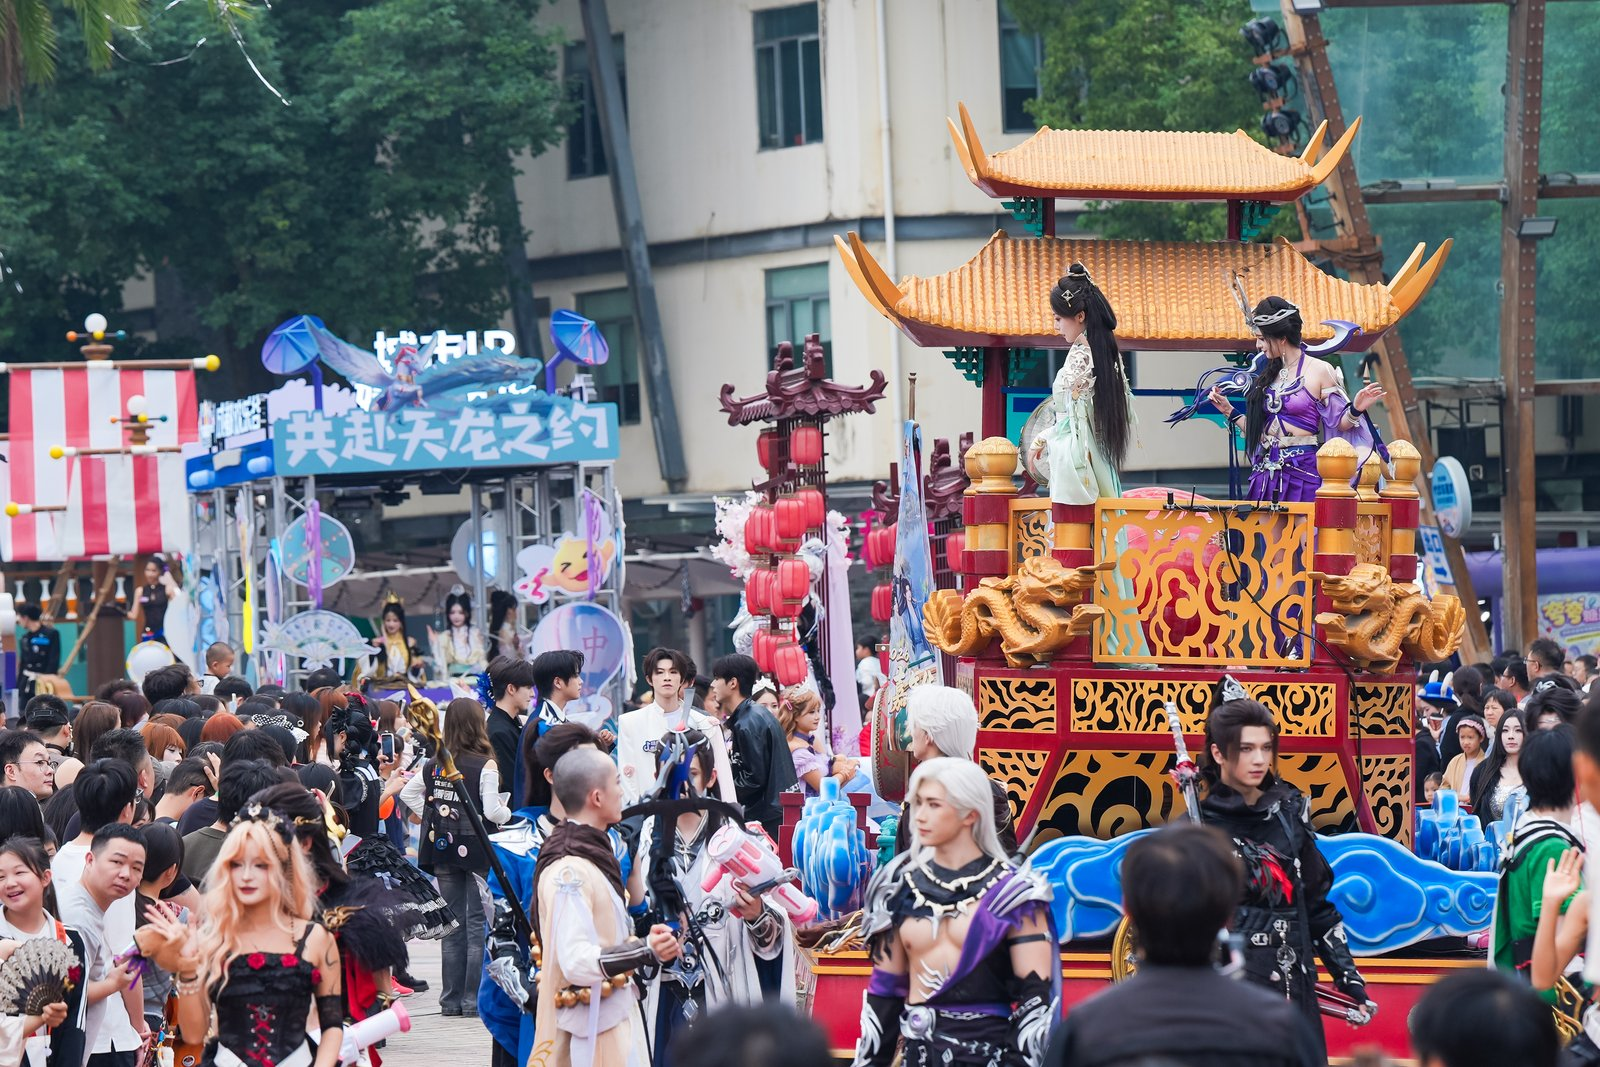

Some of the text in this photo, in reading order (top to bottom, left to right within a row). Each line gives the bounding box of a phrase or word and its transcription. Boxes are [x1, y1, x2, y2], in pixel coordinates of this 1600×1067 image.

[285, 402, 609, 468] 共赴天龙之约
[582, 626, 608, 665] 中
